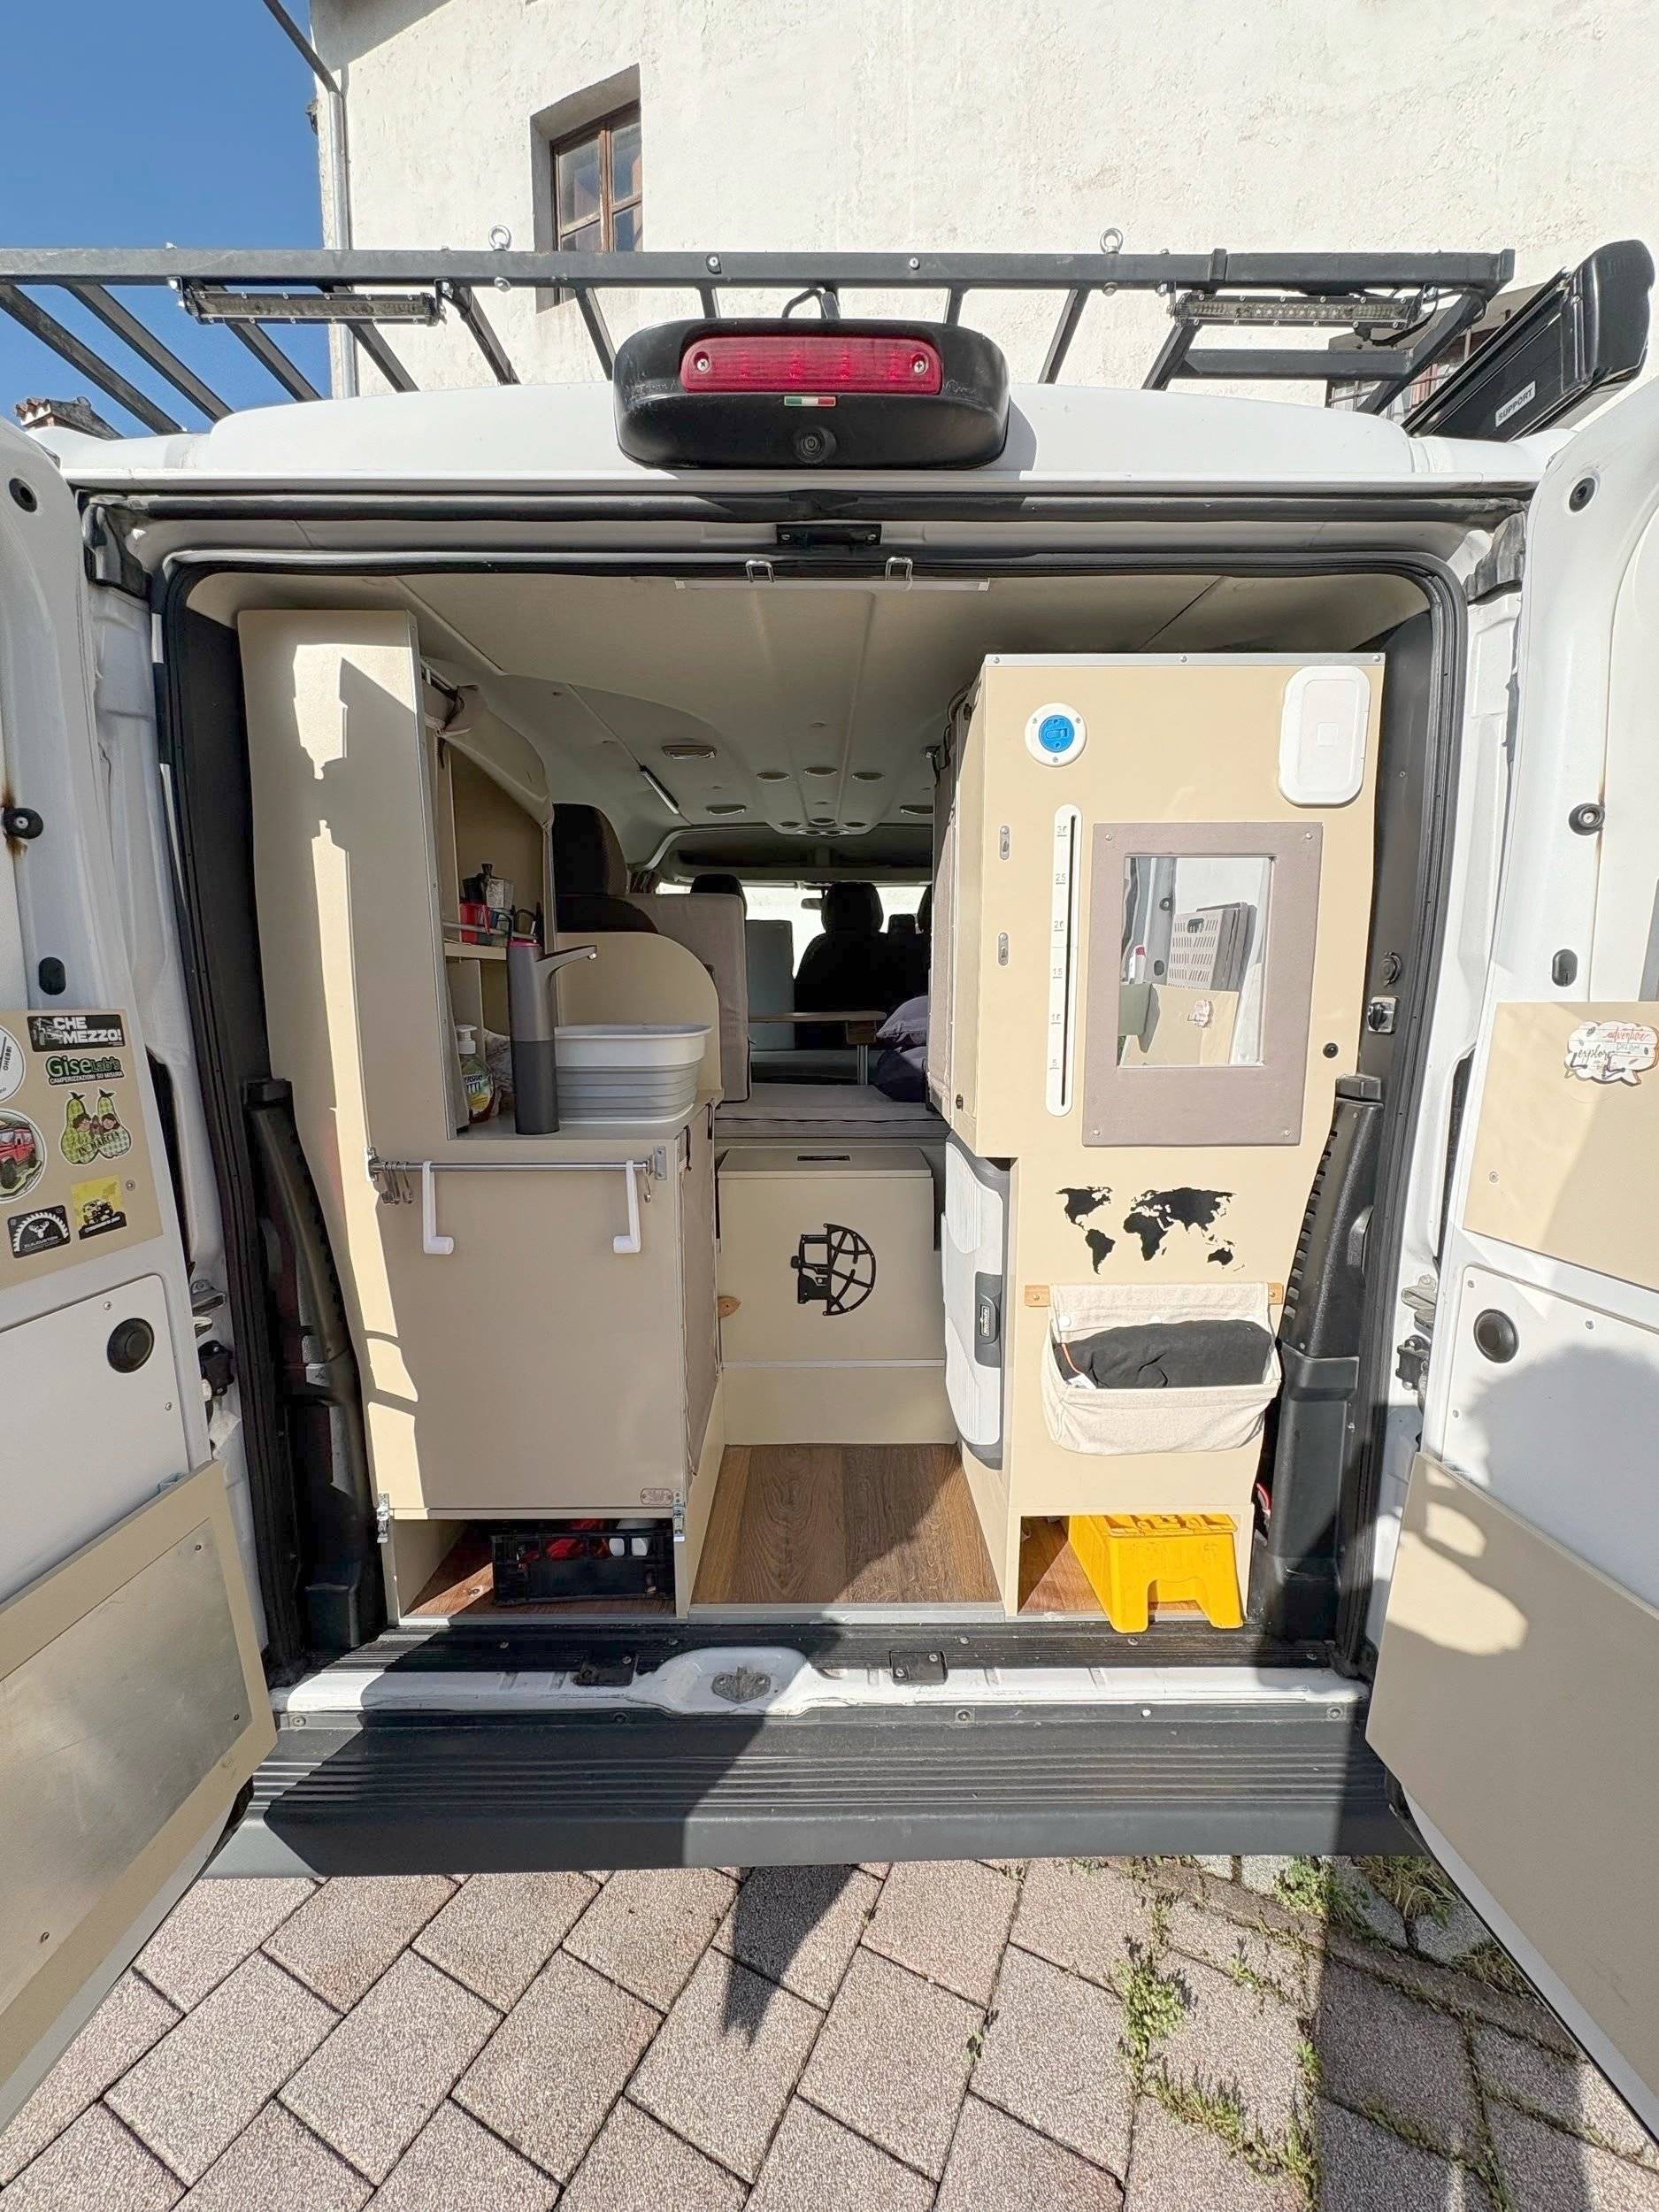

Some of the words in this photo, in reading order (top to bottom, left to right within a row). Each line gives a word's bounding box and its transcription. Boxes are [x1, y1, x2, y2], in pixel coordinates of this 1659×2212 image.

[1498, 388, 1533, 422] SUPPORT
[1056, 872, 1066, 882] 25
[1052, 967, 1063, 976] 15
[53, 1017, 87, 1030] CHE
[62, 1029, 123, 1044] MEZZO!
